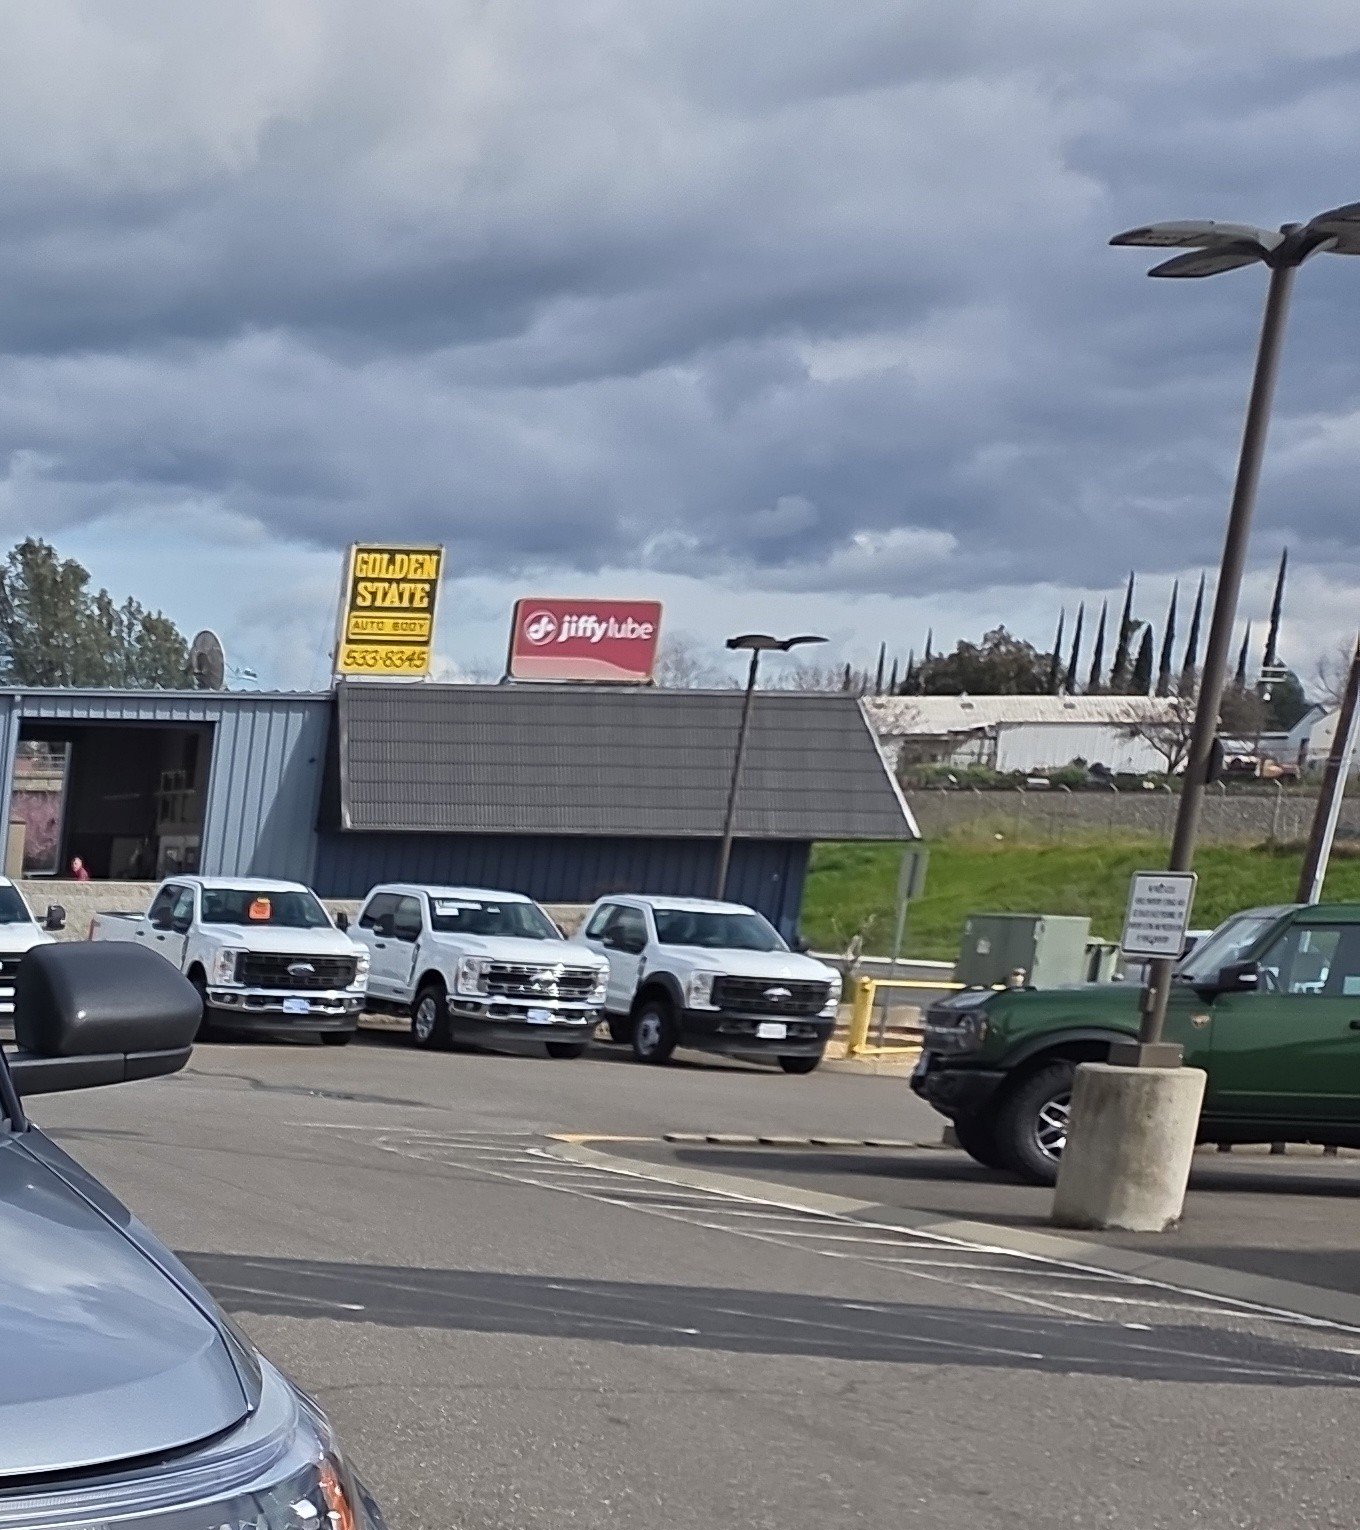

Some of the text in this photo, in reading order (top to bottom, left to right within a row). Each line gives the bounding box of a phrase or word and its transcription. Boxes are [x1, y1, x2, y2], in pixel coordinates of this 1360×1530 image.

[355, 552, 440, 579] GOLDEN
[356, 581, 430, 608] STATE
[353, 620, 426, 632] AUTO BODY
